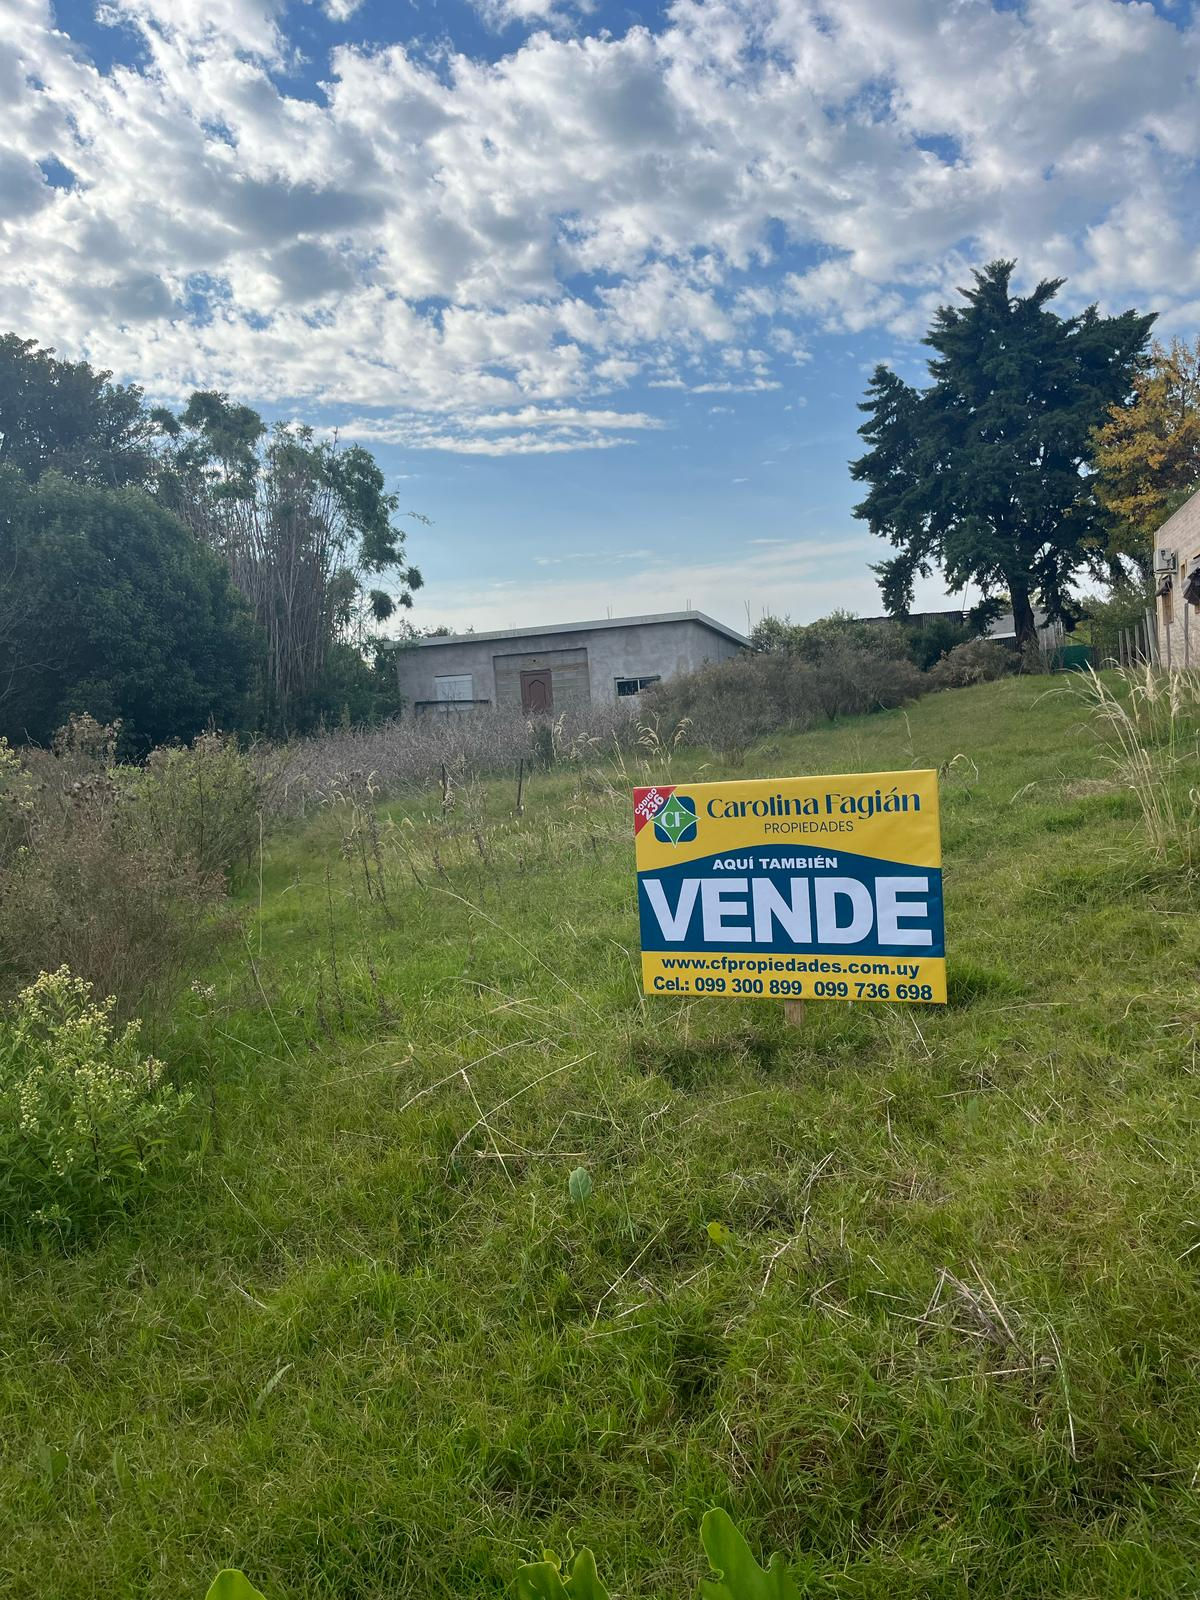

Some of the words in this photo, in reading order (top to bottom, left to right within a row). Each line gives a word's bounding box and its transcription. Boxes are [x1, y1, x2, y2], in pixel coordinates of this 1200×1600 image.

[641, 794, 664, 820] 236
[706, 794, 818, 819] Carolina
[826, 787, 920, 821] Fagián
[661, 811, 687, 828] CF
[764, 821, 854, 834] PROPIEDADES
[713, 857, 753, 870] AQUÍ
[759, 854, 838, 869] TAMBIÉN
[641, 877, 933, 946] VENDE
[662, 957, 920, 978] www.cfpropiedades.com.uy
[653, 977, 689, 991] Cel.:
[695, 977, 726, 993] 099
[732, 978, 764, 994] 300
[769, 979, 802, 995] 899
[814, 982, 848, 998] 099
[854, 983, 890, 999] 736
[896, 984, 932, 1001] 698
